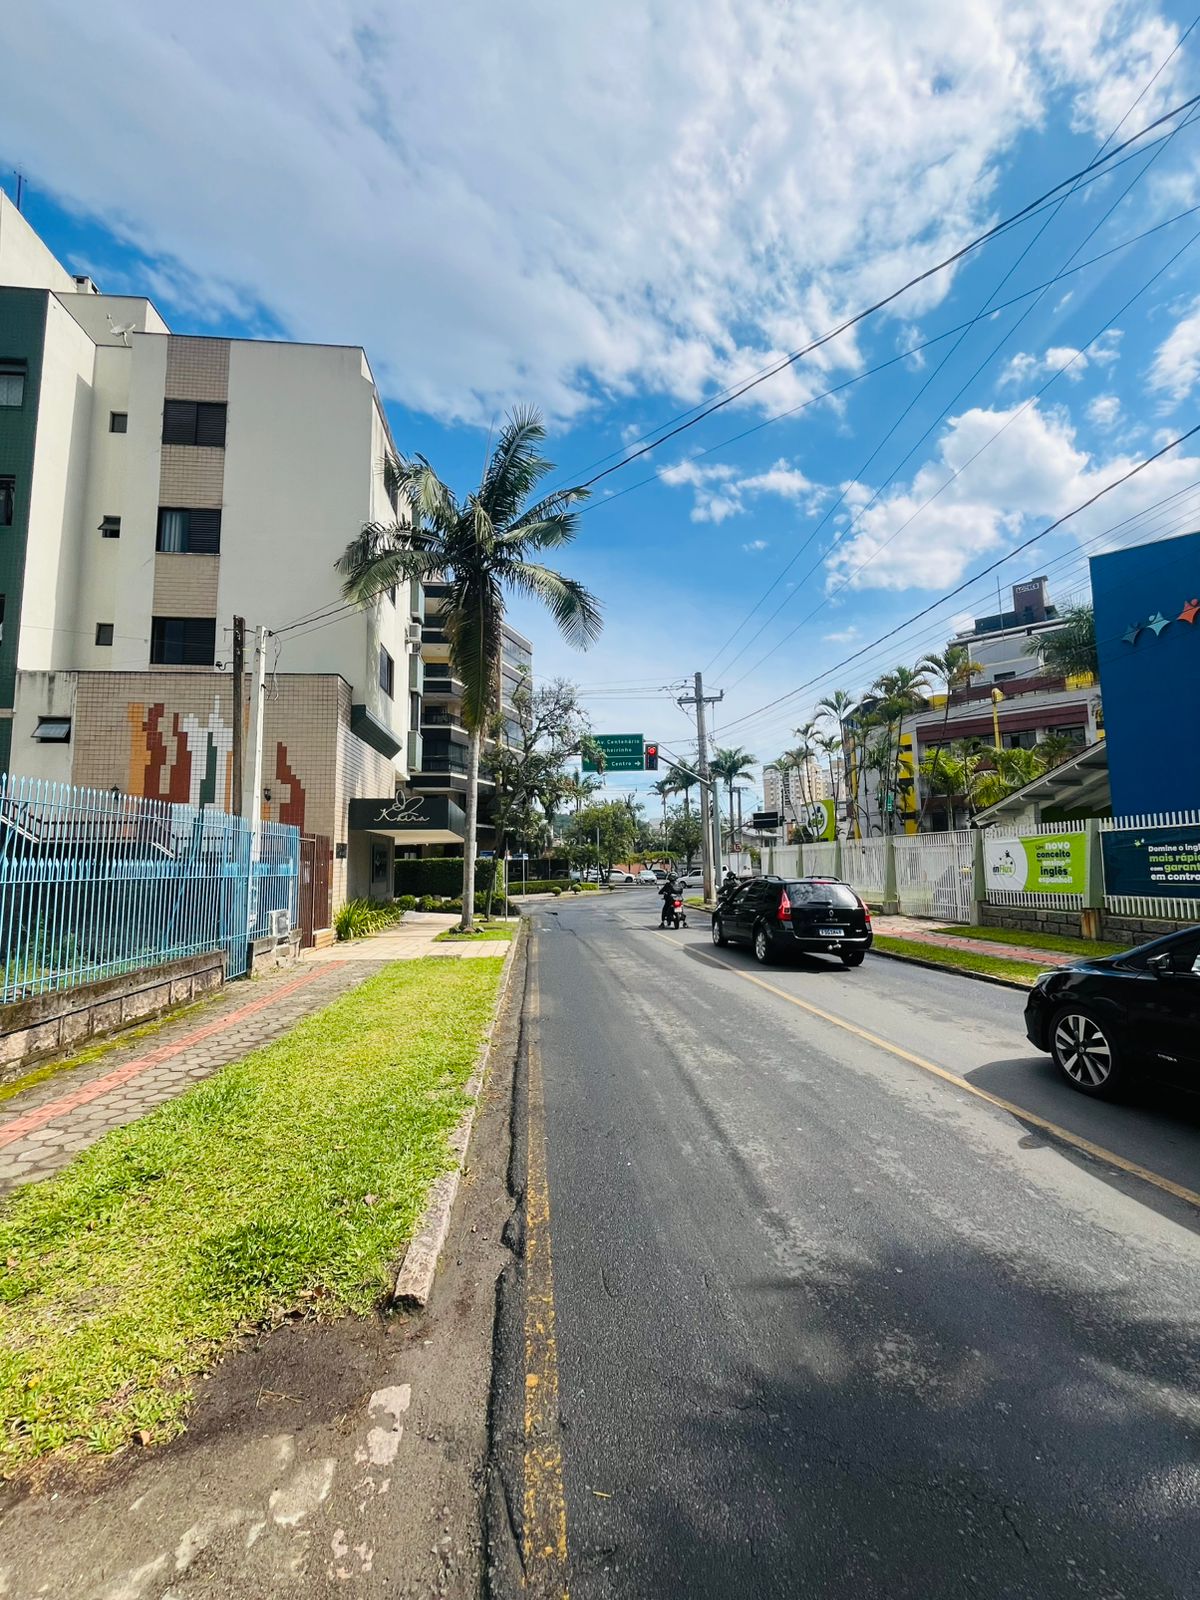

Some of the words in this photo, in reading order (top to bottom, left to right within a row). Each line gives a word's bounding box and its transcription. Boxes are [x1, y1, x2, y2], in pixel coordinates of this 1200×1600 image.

[1045, 842, 1070, 850] novo
[1036, 850, 1070, 858] conceito
[1149, 853, 1174, 862] mais
[1040, 866, 1068, 877] inglês
